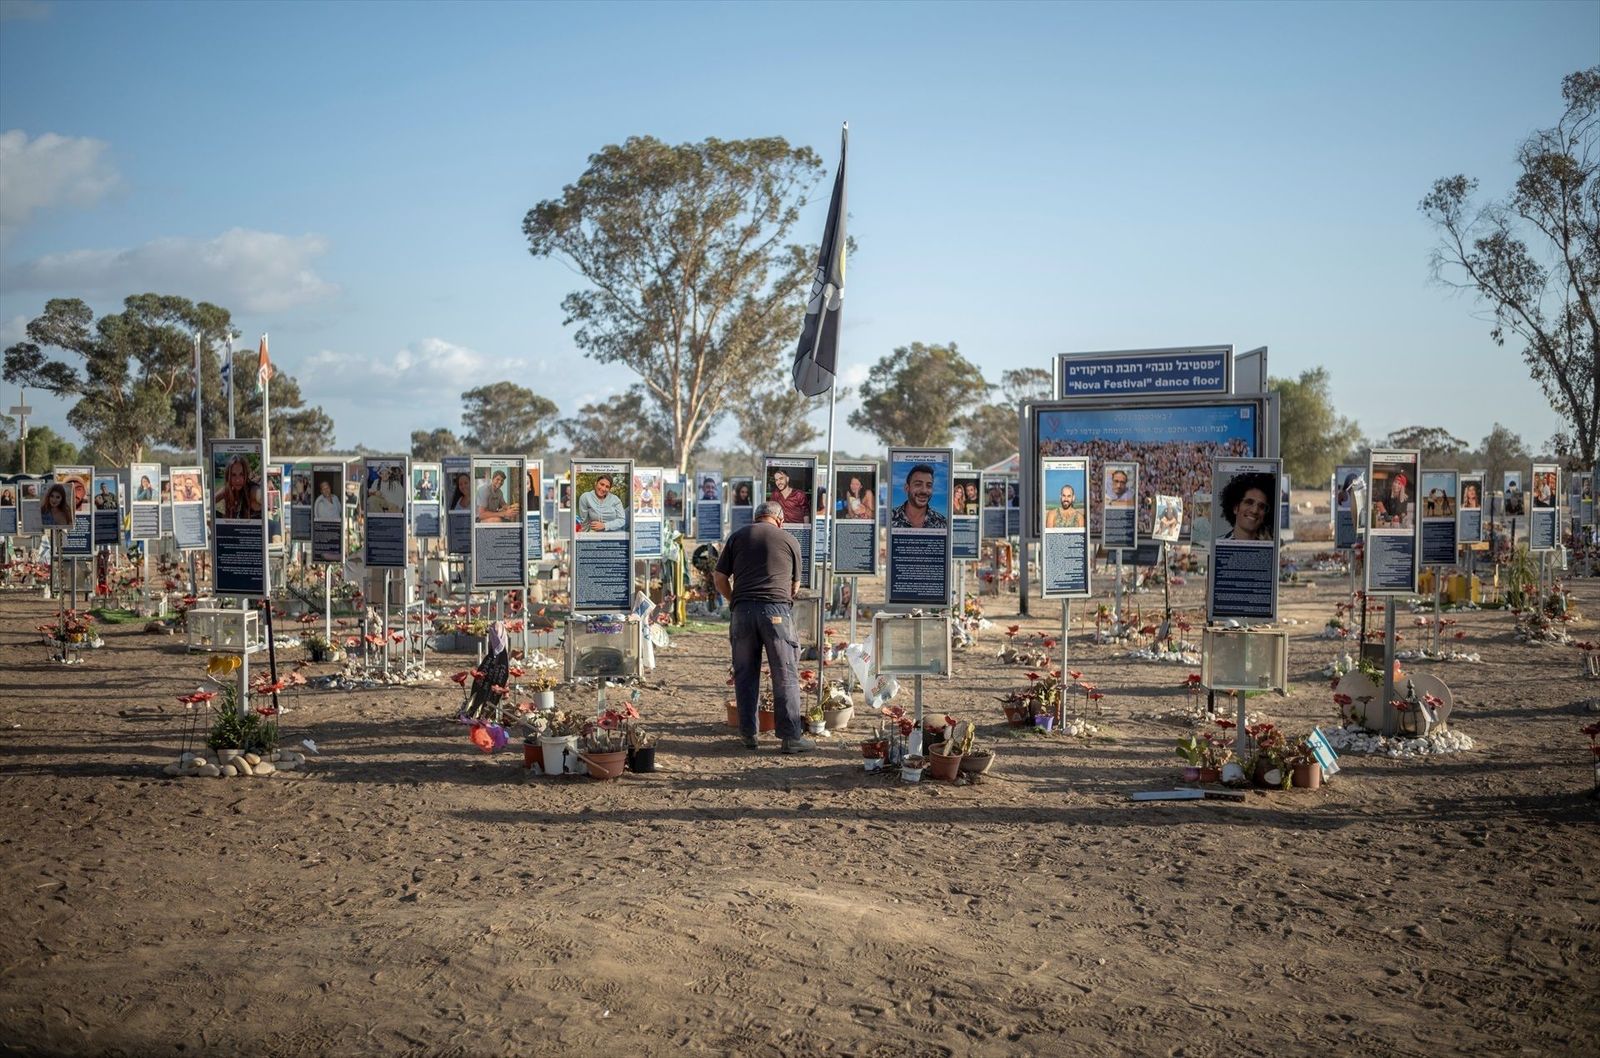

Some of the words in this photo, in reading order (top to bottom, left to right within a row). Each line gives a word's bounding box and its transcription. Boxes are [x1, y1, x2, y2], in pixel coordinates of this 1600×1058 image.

[1069, 364, 1113, 376] הריקודים
[1115, 363, 1143, 374] רחבת
[1069, 380, 1100, 390] “Nova
[1103, 378, 1152, 389] Festival”
[1155, 377, 1189, 387] dance
[1192, 376, 1220, 386] floor
